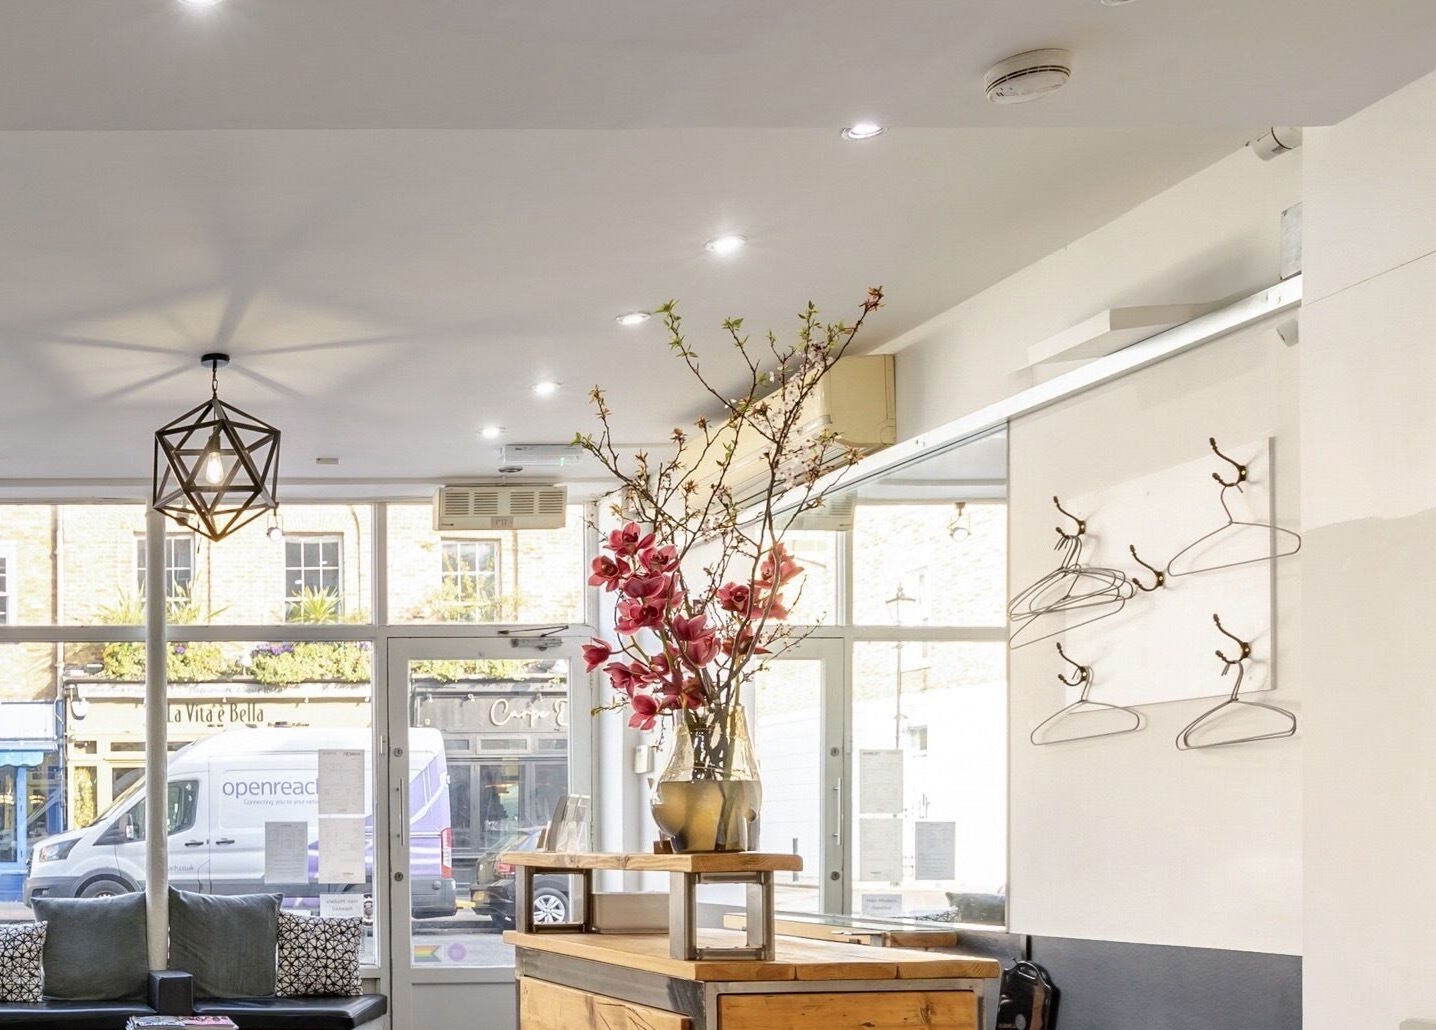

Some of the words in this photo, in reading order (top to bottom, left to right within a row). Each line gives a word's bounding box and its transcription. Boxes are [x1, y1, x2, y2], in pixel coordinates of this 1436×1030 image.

[167, 704, 181, 723] La
[185, 703, 213, 723] Vita
[230, 703, 264, 723] Bella
